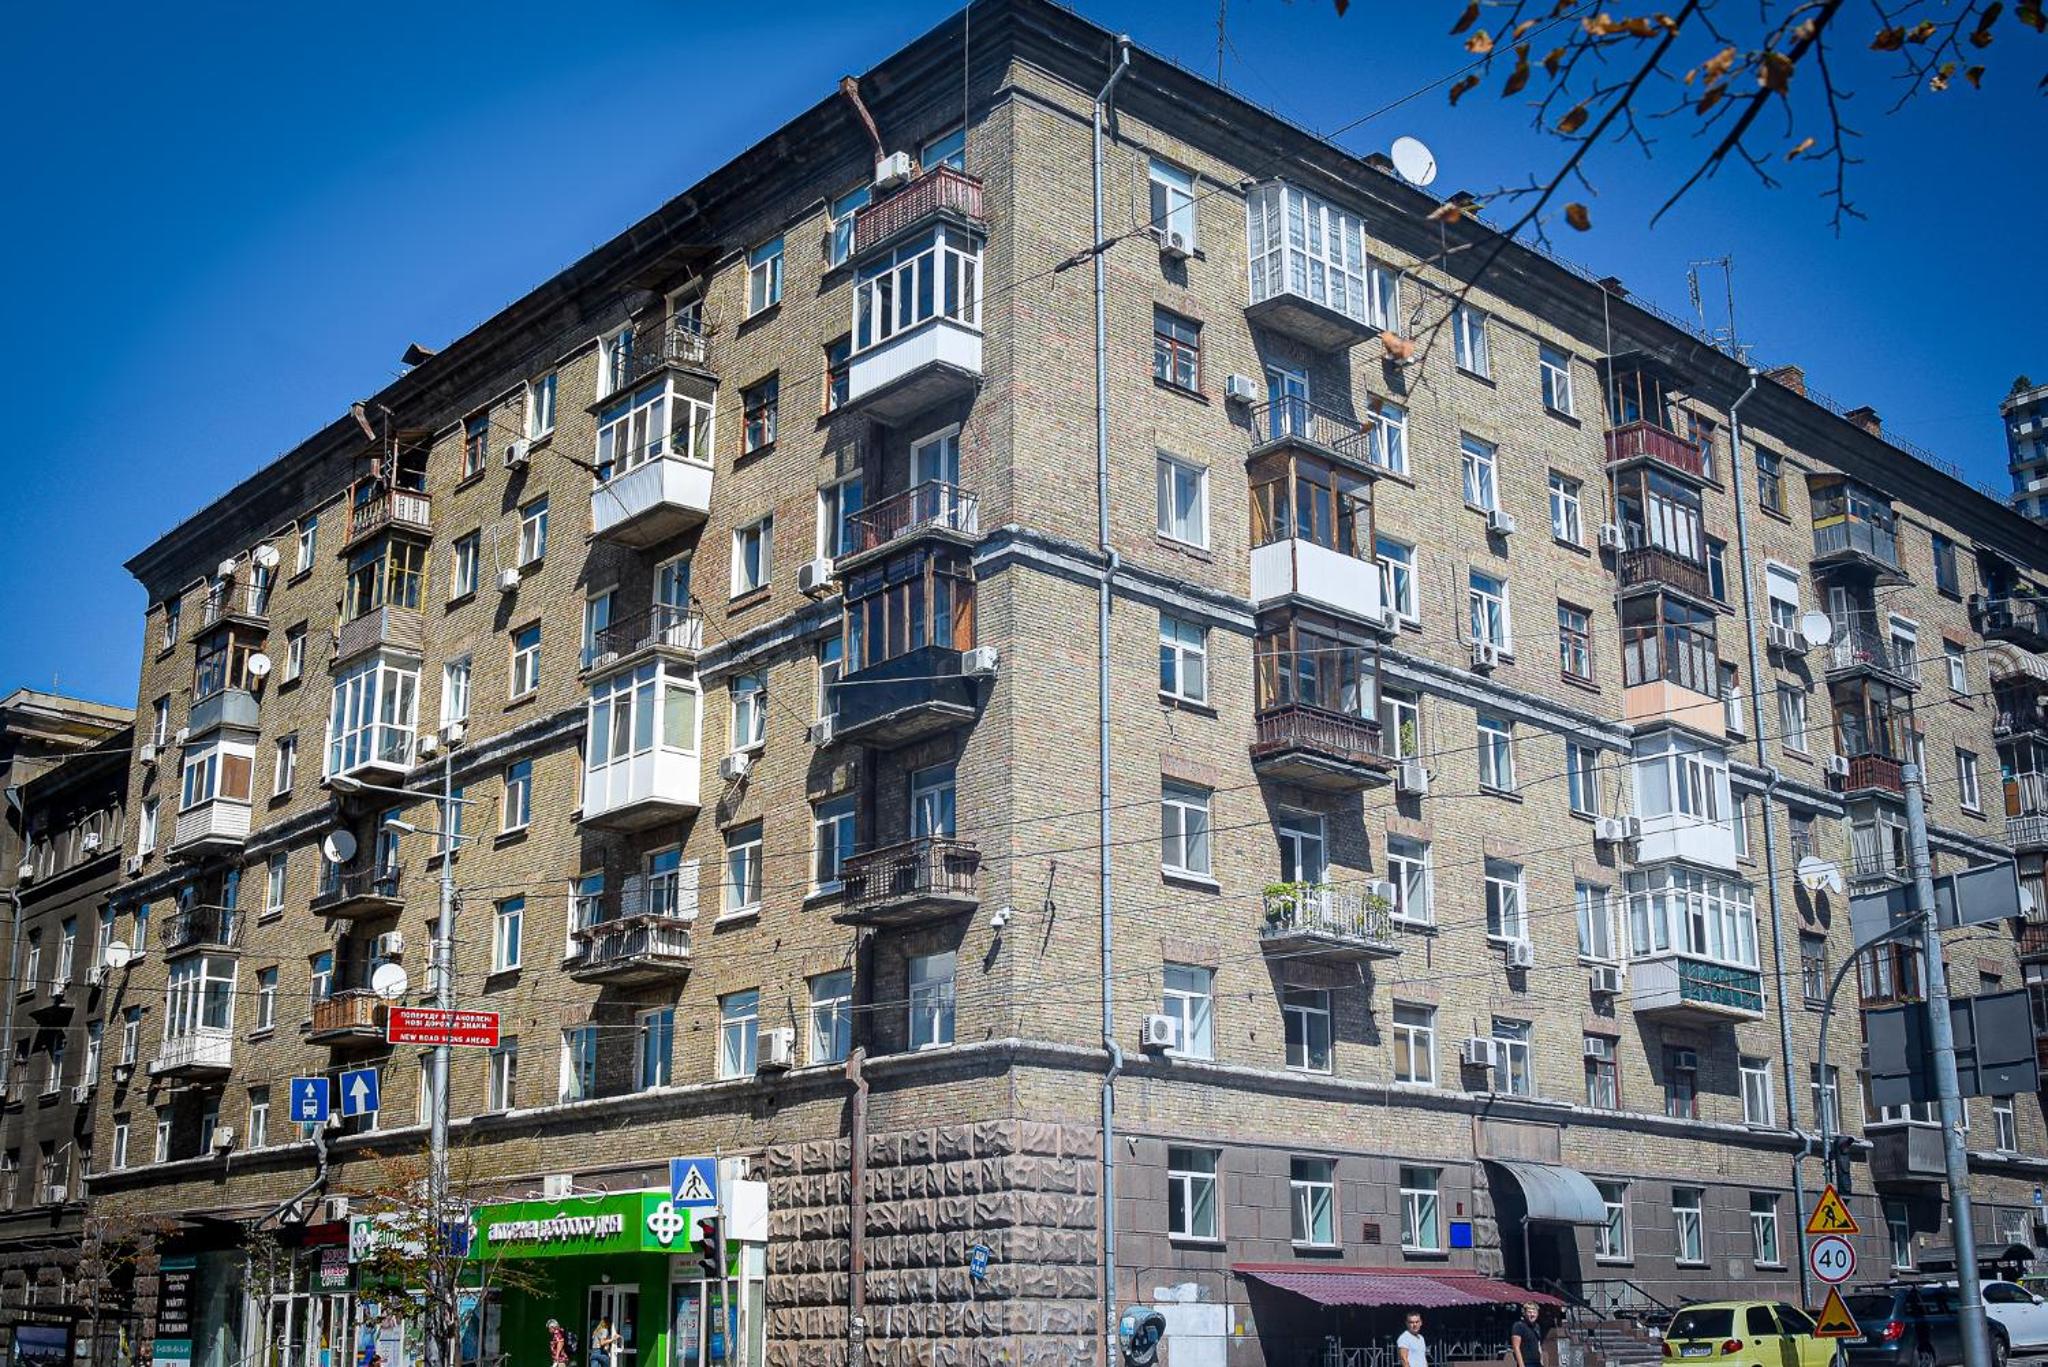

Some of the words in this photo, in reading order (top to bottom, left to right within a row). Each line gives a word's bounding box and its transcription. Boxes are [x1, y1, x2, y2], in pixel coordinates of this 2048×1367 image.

[400, 1033, 416, 1041] NEW
[418, 1034, 439, 1042] ROAD
[465, 1037, 491, 1045] AHEAD
[1819, 1249, 1847, 1268] 40
